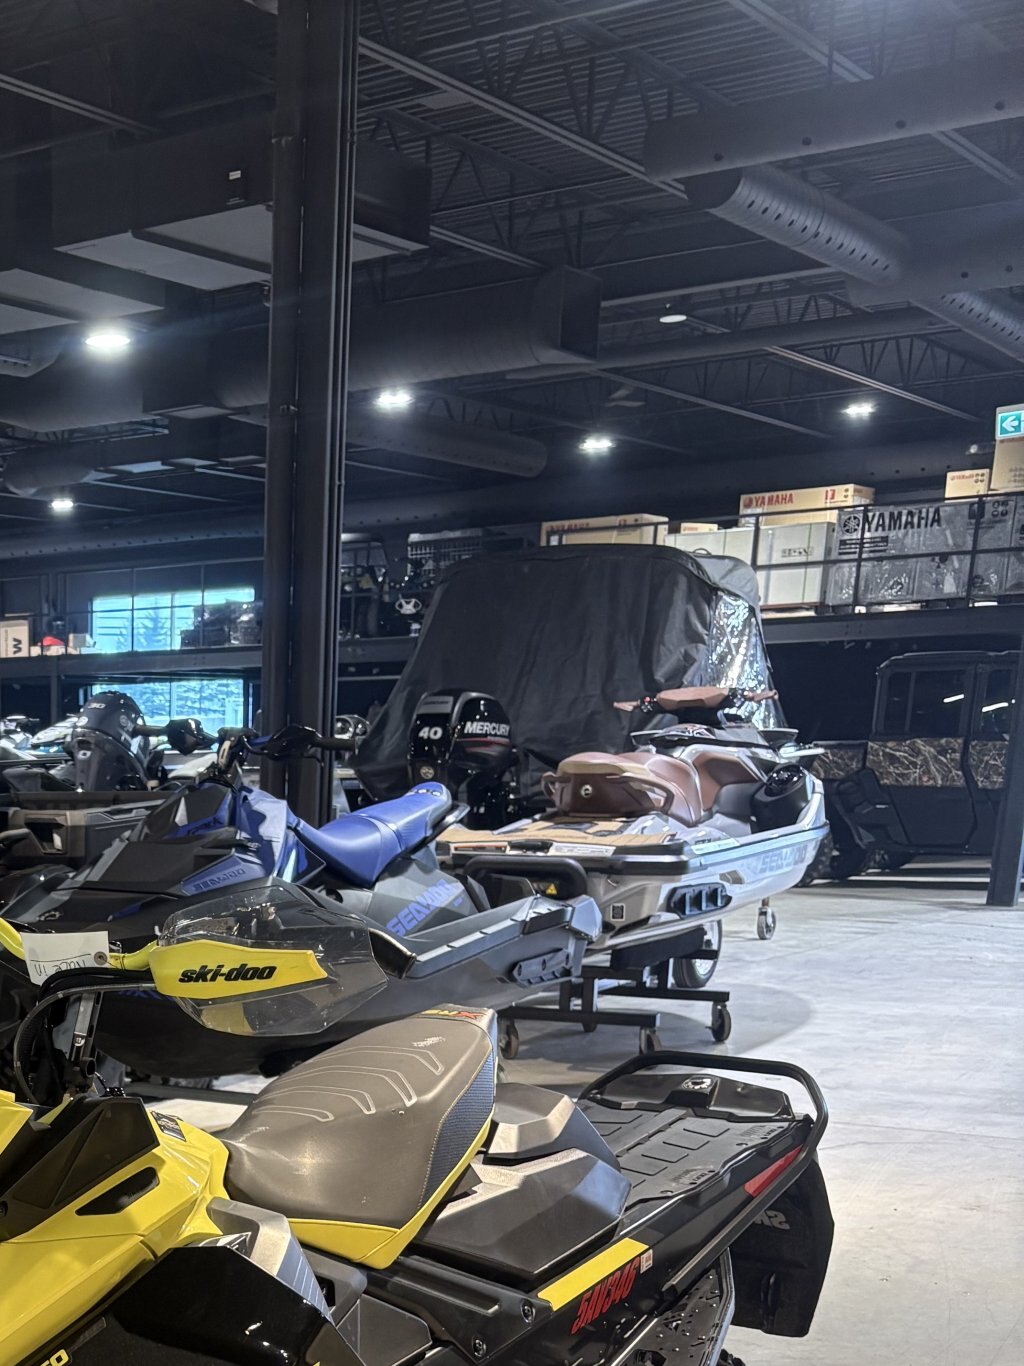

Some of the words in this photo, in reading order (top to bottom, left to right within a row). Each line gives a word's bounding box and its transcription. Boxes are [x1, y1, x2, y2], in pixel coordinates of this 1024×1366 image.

[754, 492, 794, 508] YAMAHA
[864, 506, 943, 533] YAMAHA
[417, 726, 443, 740] 40
[463, 721, 511, 736] MERCURY
[178, 964, 277, 983] ski-doo
